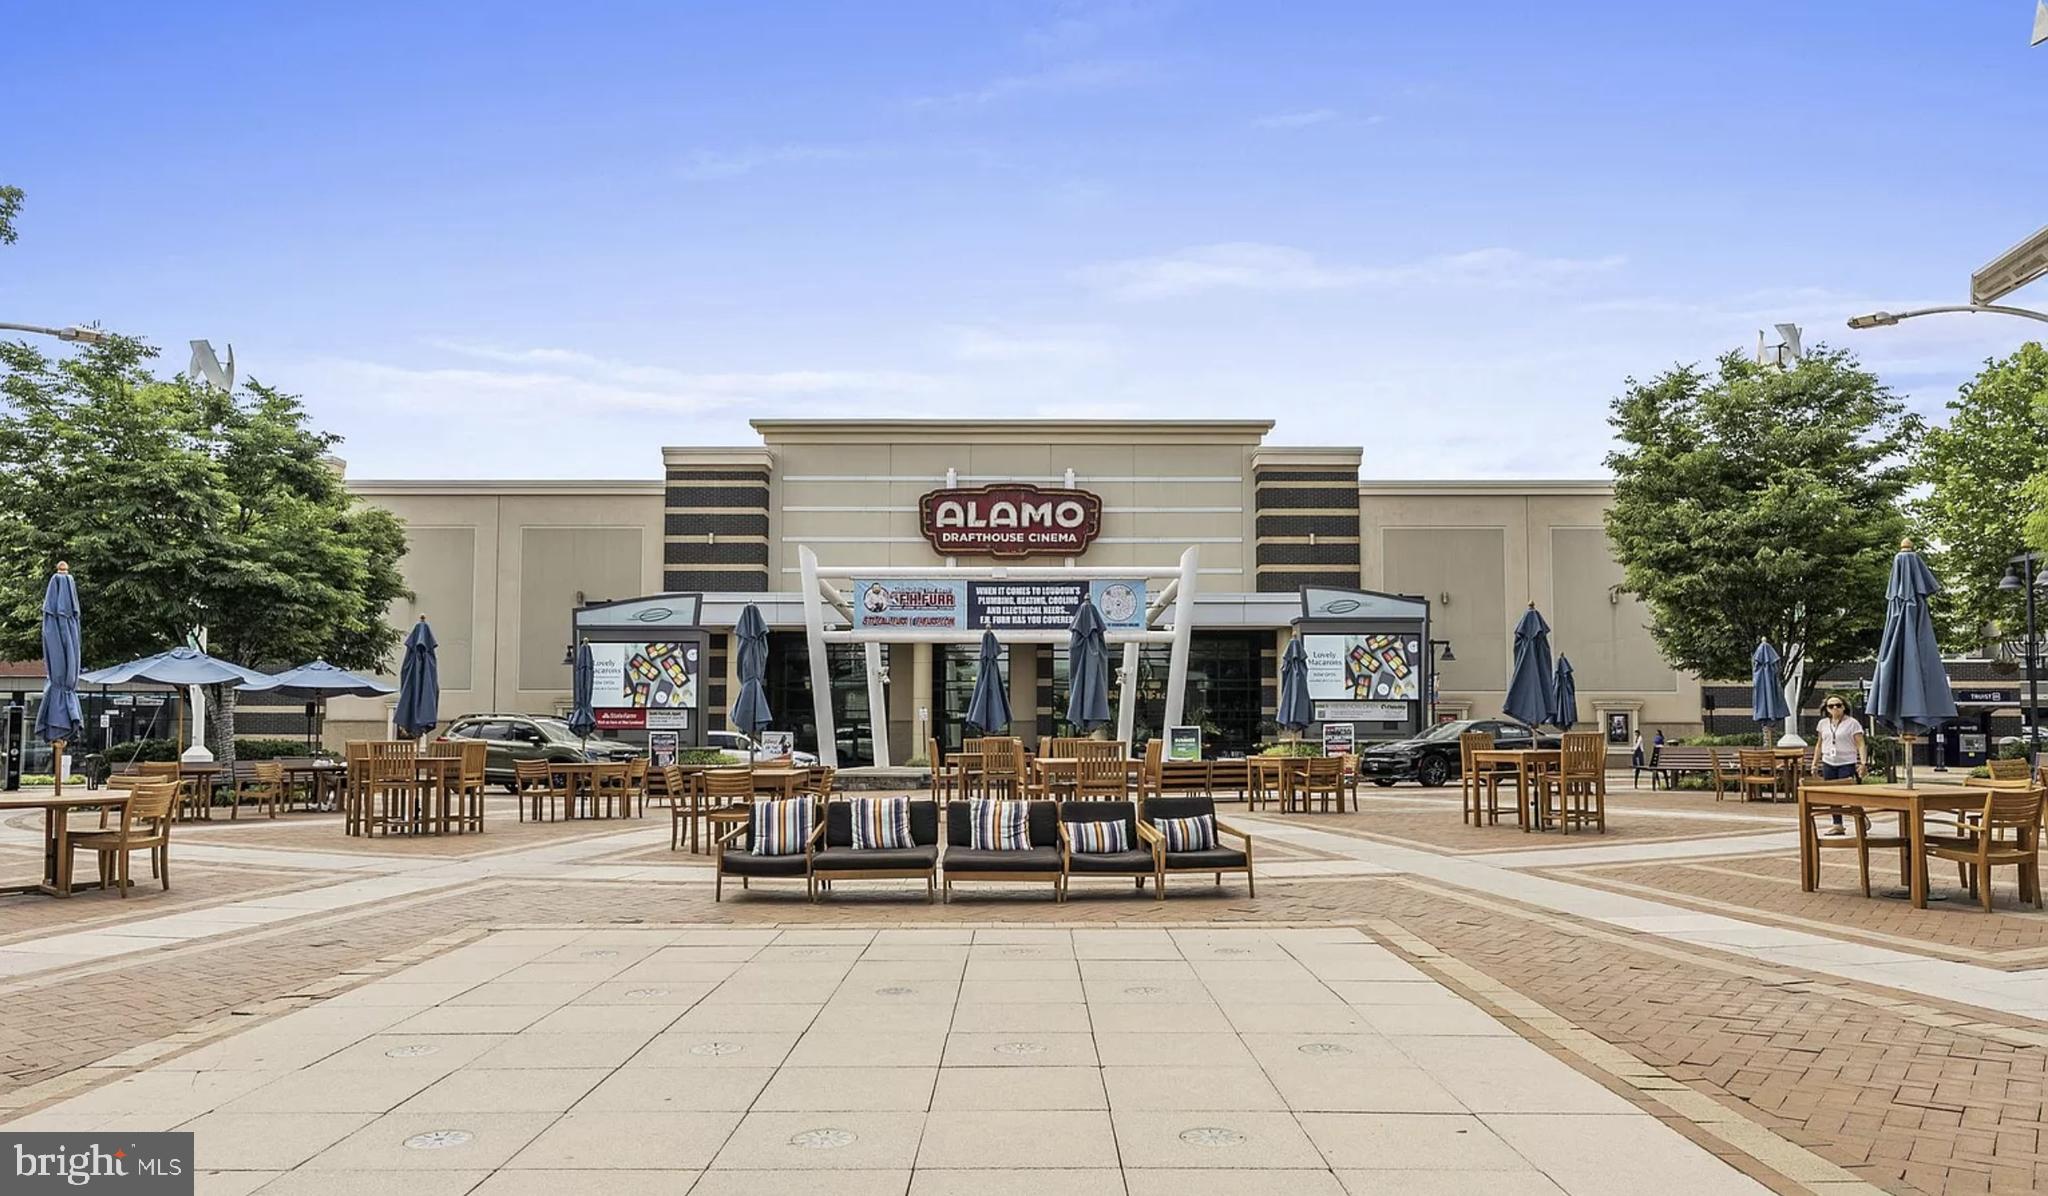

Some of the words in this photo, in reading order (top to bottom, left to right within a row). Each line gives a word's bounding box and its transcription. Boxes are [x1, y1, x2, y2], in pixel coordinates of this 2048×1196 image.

[936, 500, 1085, 528] ALAMO
[942, 532, 1024, 543] DRAFTHOUSE
[1028, 532, 1077, 543] CINEMA
[976, 586, 998, 595] WHEN
[998, 586, 1005, 595] IT
[1006, 586, 1030, 595] COMES
[1031, 586, 1041, 595] TO
[1042, 586, 1081, 596] LOUDOUN'S
[1048, 596, 1079, 605] COOLING
[986, 606, 1002, 615] AND
[1002, 606, 1042, 615] ELECTRICAL
[992, 615, 1011, 624] FURR
[1012, 615, 1026, 624] HAS
[1027, 615, 1042, 624] YOU
[1313, 651, 1336, 659] Lovely
